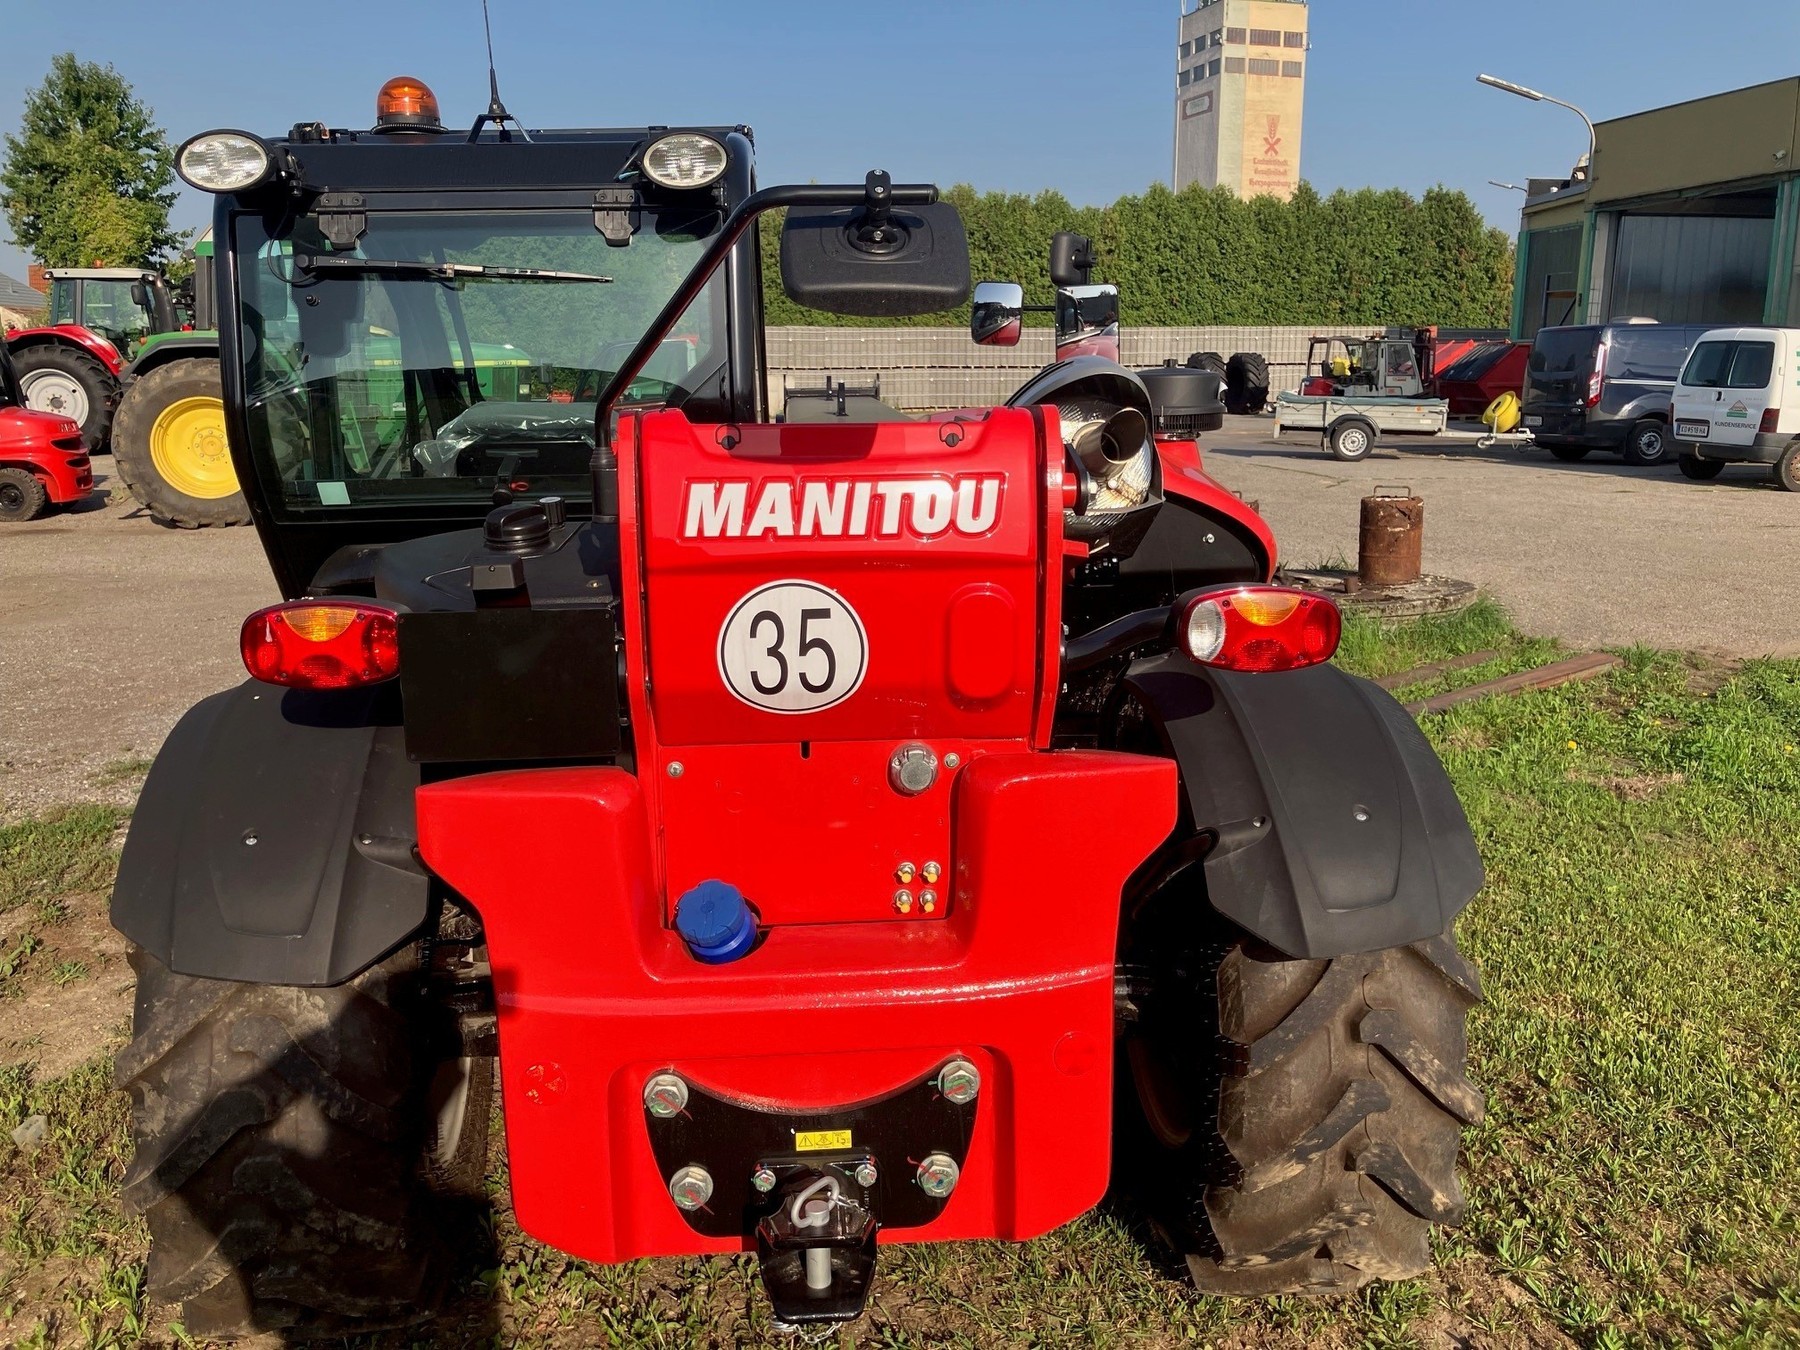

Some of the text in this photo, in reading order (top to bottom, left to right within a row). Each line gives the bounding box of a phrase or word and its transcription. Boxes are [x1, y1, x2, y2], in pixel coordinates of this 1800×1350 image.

[1714, 421, 1757, 430] KUNDENSERVICE
[684, 479, 1000, 538] MANITOU
[749, 607, 837, 696] 35
